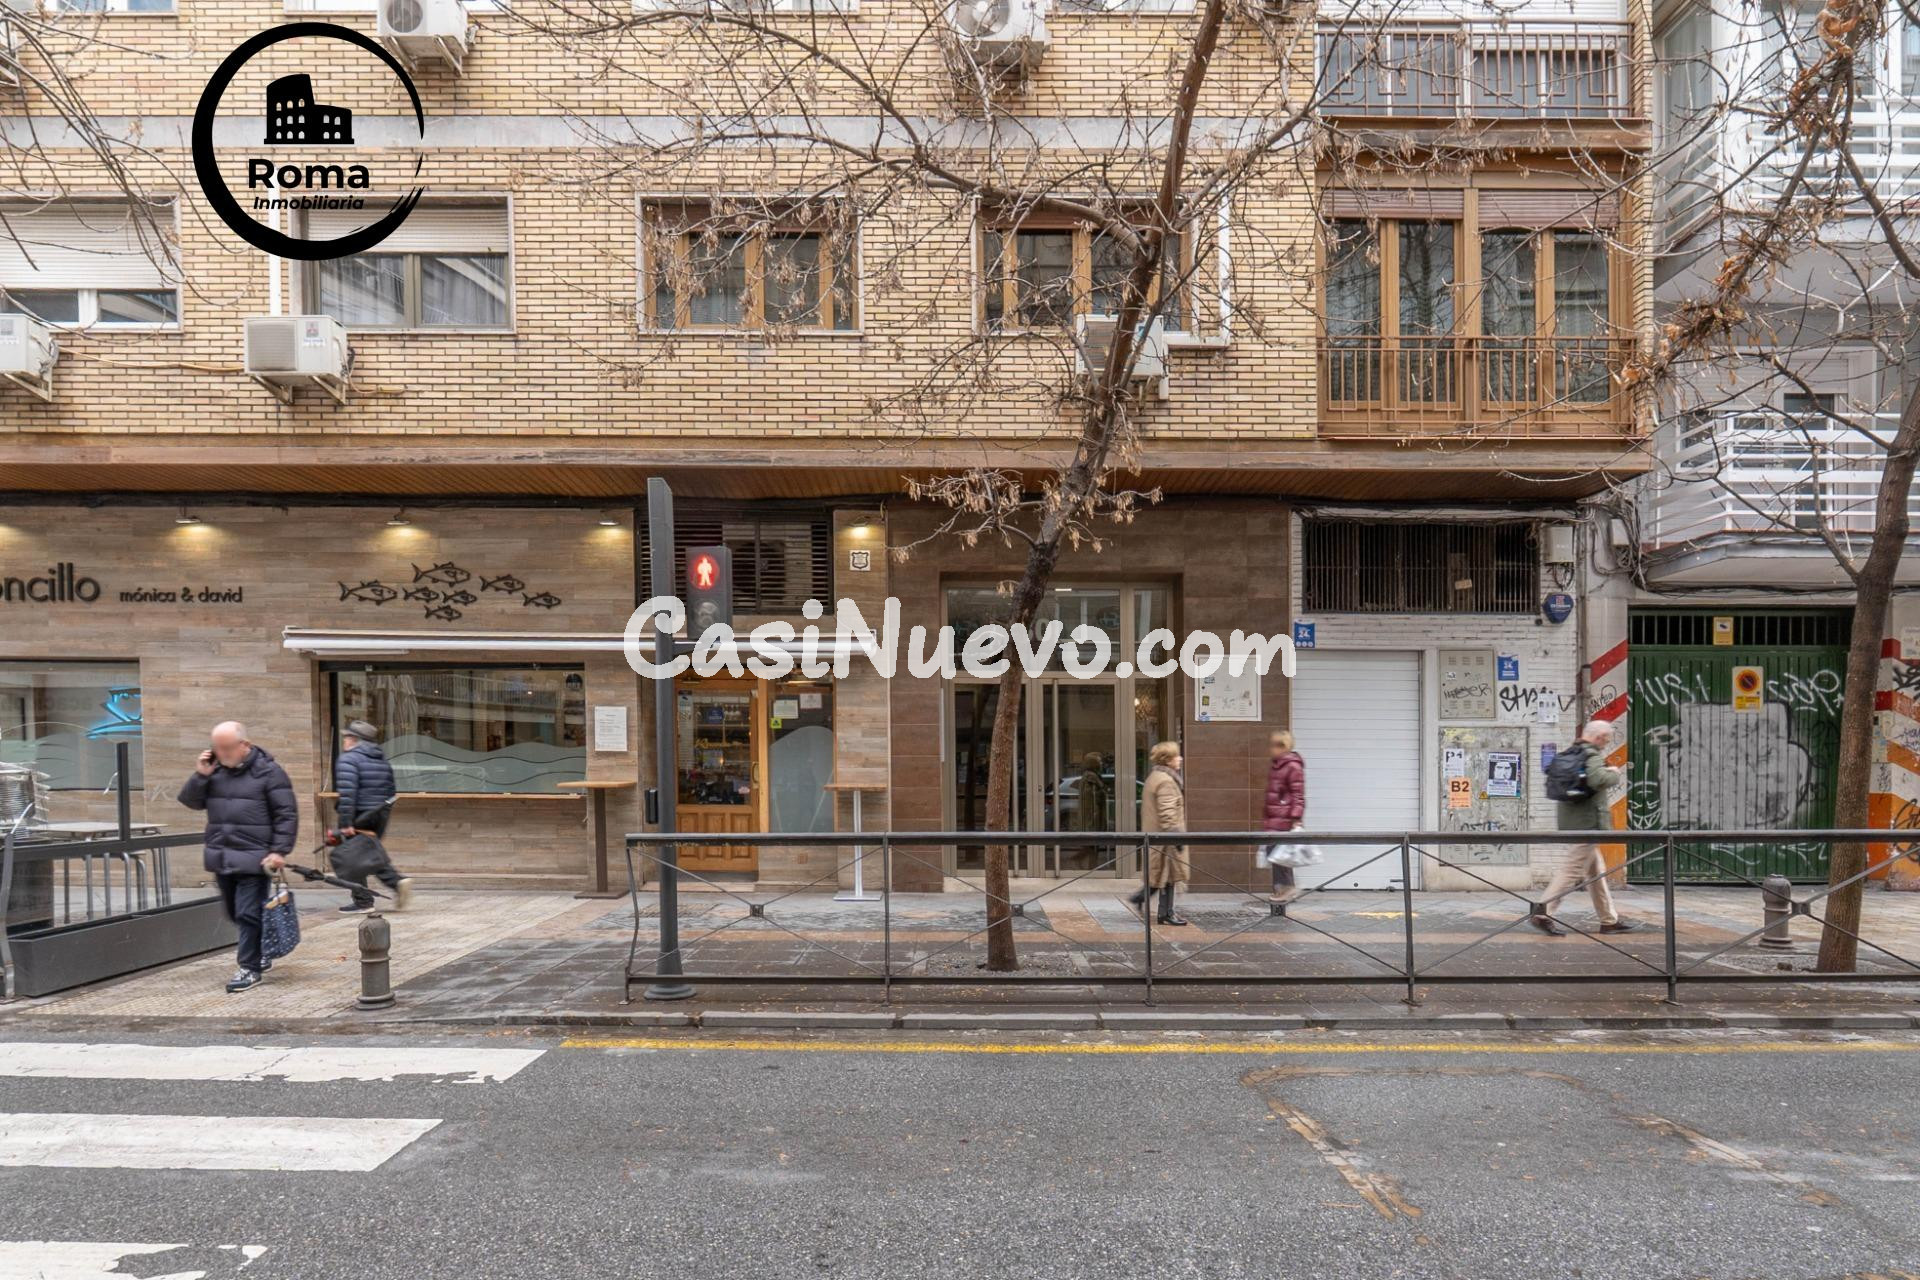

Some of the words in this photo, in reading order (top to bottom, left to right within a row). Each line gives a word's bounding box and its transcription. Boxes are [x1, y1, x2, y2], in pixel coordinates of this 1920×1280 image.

[0, 562, 101, 603] ncillo
[119, 587, 176, 603] mónica
[181, 586, 194, 603] &
[198, 586, 243, 603] david
[1451, 780, 1470, 793] B2
